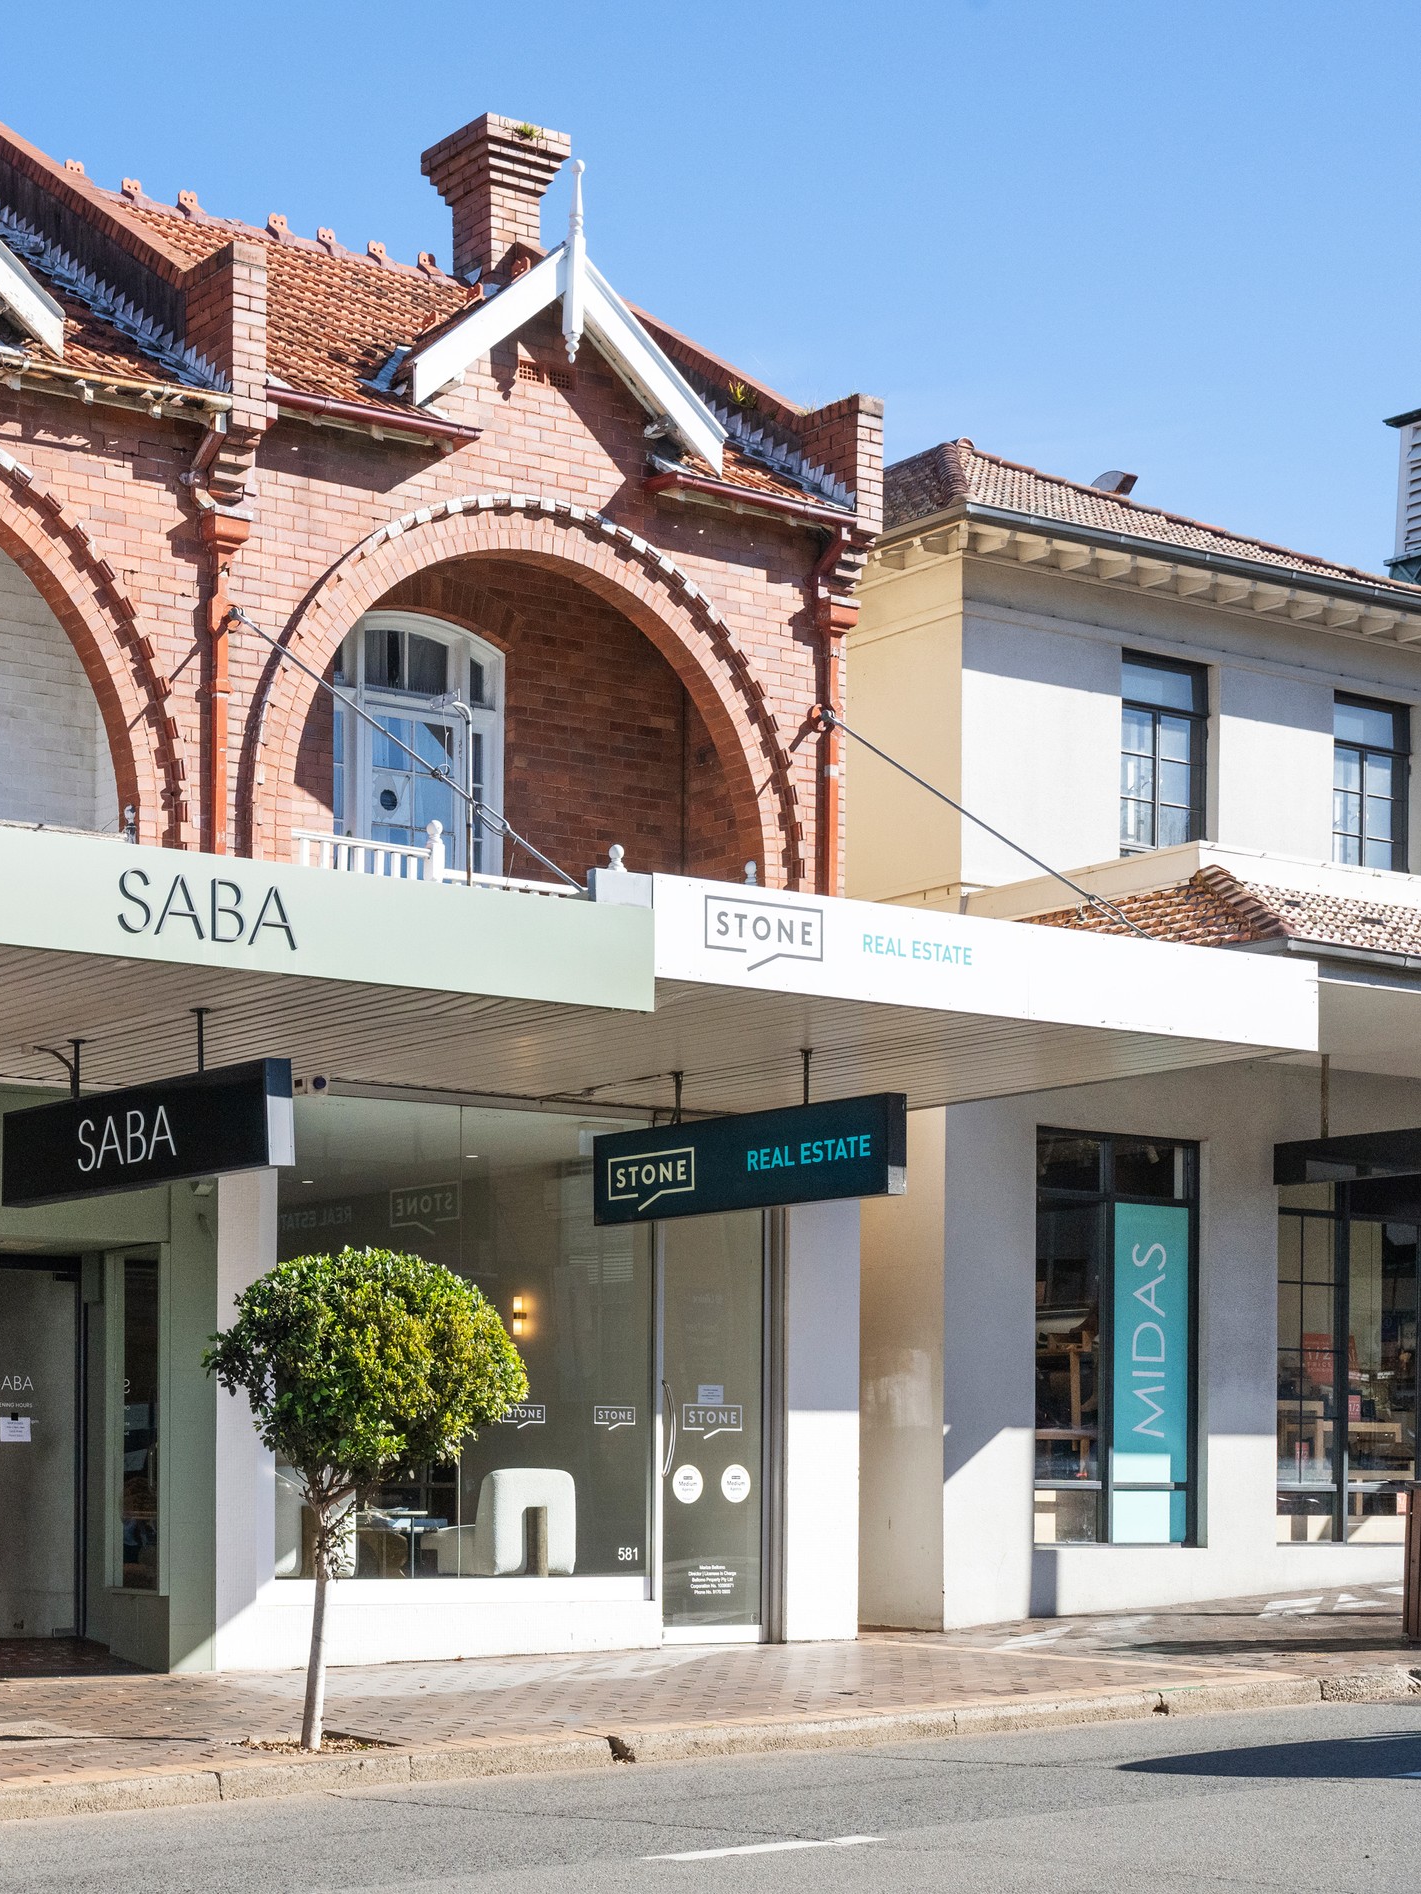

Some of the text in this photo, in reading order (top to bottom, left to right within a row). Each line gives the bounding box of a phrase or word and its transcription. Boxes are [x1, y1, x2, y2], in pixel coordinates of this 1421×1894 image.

[117, 866, 299, 951] SABA
[716, 910, 973, 966] STONE REAL ESTATE
[77, 1105, 178, 1172] SABA
[615, 1134, 871, 1189] STONE REAL ESTATE
[1131, 1242, 1167, 1438] MIDAS
[506, 1409, 542, 1419] STONE
[597, 1410, 633, 1421] STONE
[688, 1410, 738, 1425] STONE
[617, 1546, 638, 1561] 581
